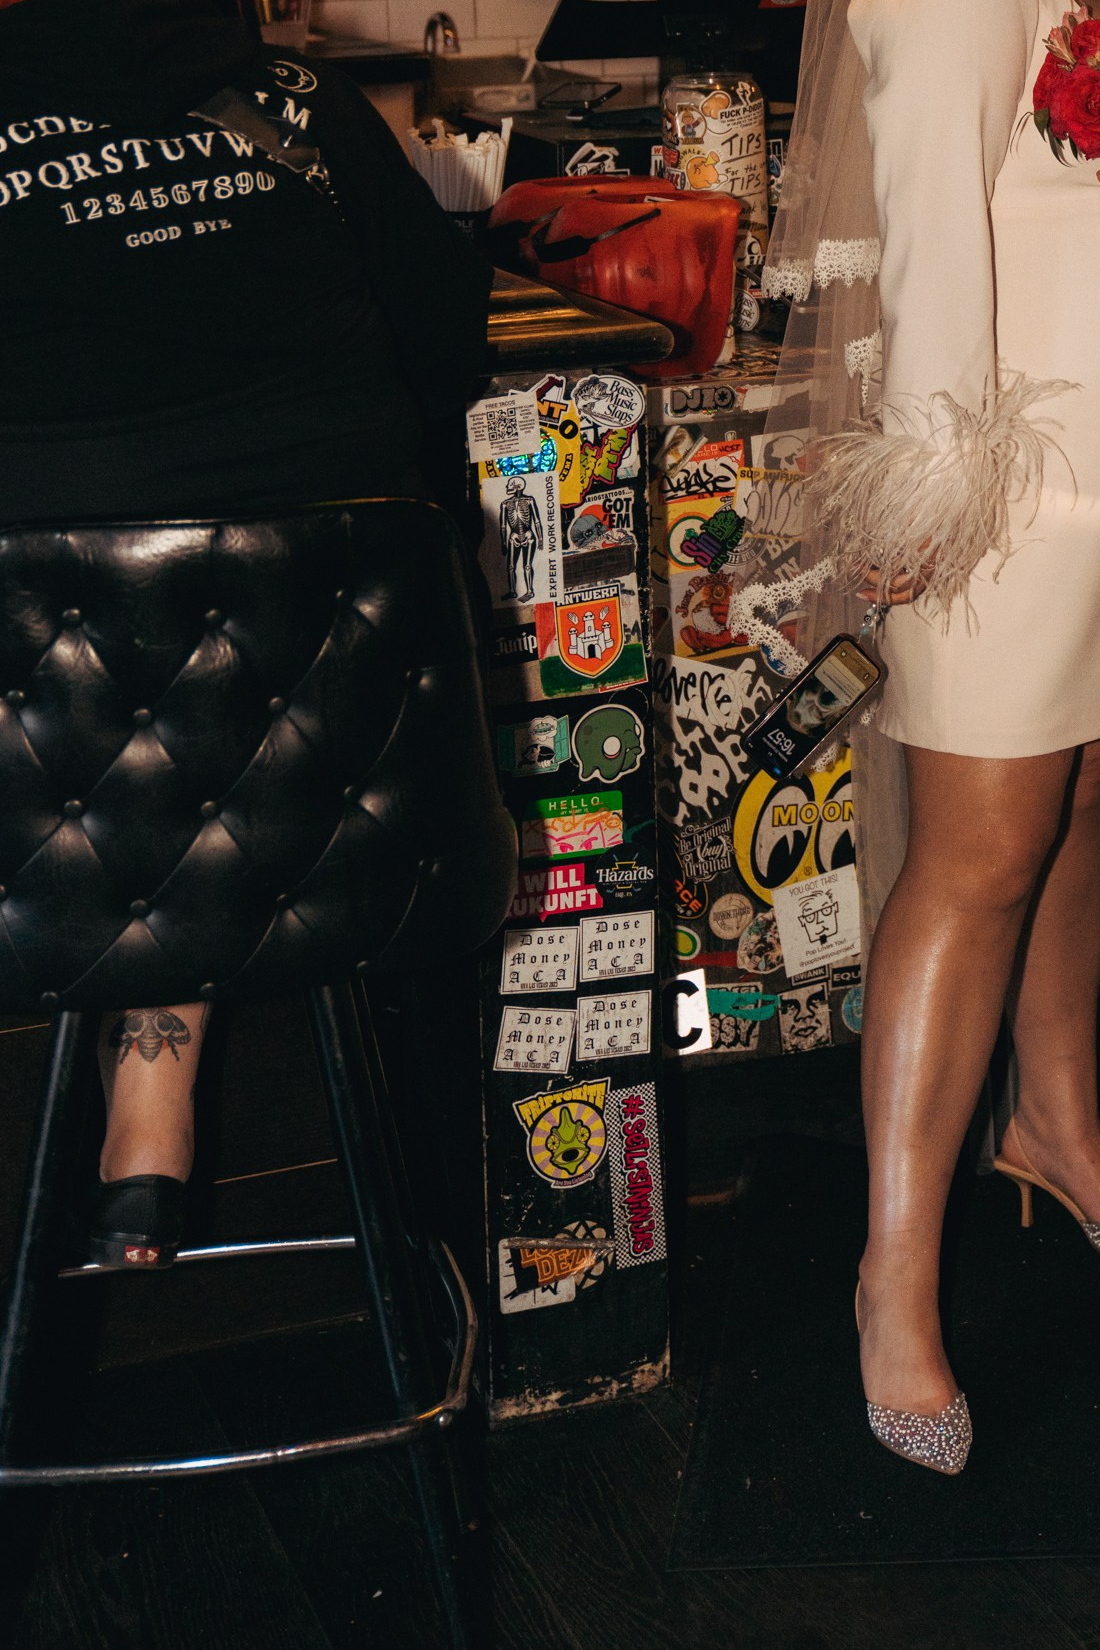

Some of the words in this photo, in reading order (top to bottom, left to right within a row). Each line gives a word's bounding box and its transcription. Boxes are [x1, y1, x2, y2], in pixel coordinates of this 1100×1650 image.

[720, 108, 741, 120] FUCK
[0, 116, 112, 152] CDE
[721, 132, 763, 157] TIPS
[60, 170, 276, 225] 1234567890
[125, 226, 182, 249] GOOD
[192, 218, 232, 236] BYE
[609, 381, 634, 398] Bass
[485, 402, 498, 410] FREE
[608, 393, 637, 411] Music
[604, 405, 634, 424] Slaps
[739, 468, 760, 479] SUP
[546, 475, 556, 522] RECORDS
[601, 498, 632, 514] GOT
[548, 523, 557, 558] WORK
[549, 558, 557, 599] EXPERT
[767, 728, 797, 755] 16:57
[549, 796, 601, 812] HELLO
[524, 868, 582, 894] WILL
[596, 865, 655, 883] Hazards
[789, 884, 805, 898] YOU
[806, 880, 822, 892] GOT
[508, 890, 599, 918] UKUNFT
[596, 919, 641, 934] Dose
[519, 934, 566, 947] Dose
[586, 937, 647, 954] Money
[805, 948, 816, 957] Pop
[816, 943, 832, 954] Loves
[509, 952, 571, 967] Money
[592, 999, 638, 1013] Dose
[517, 1011, 563, 1026] Dose
[583, 1016, 643, 1034] Money
[505, 1030, 566, 1048] Money
